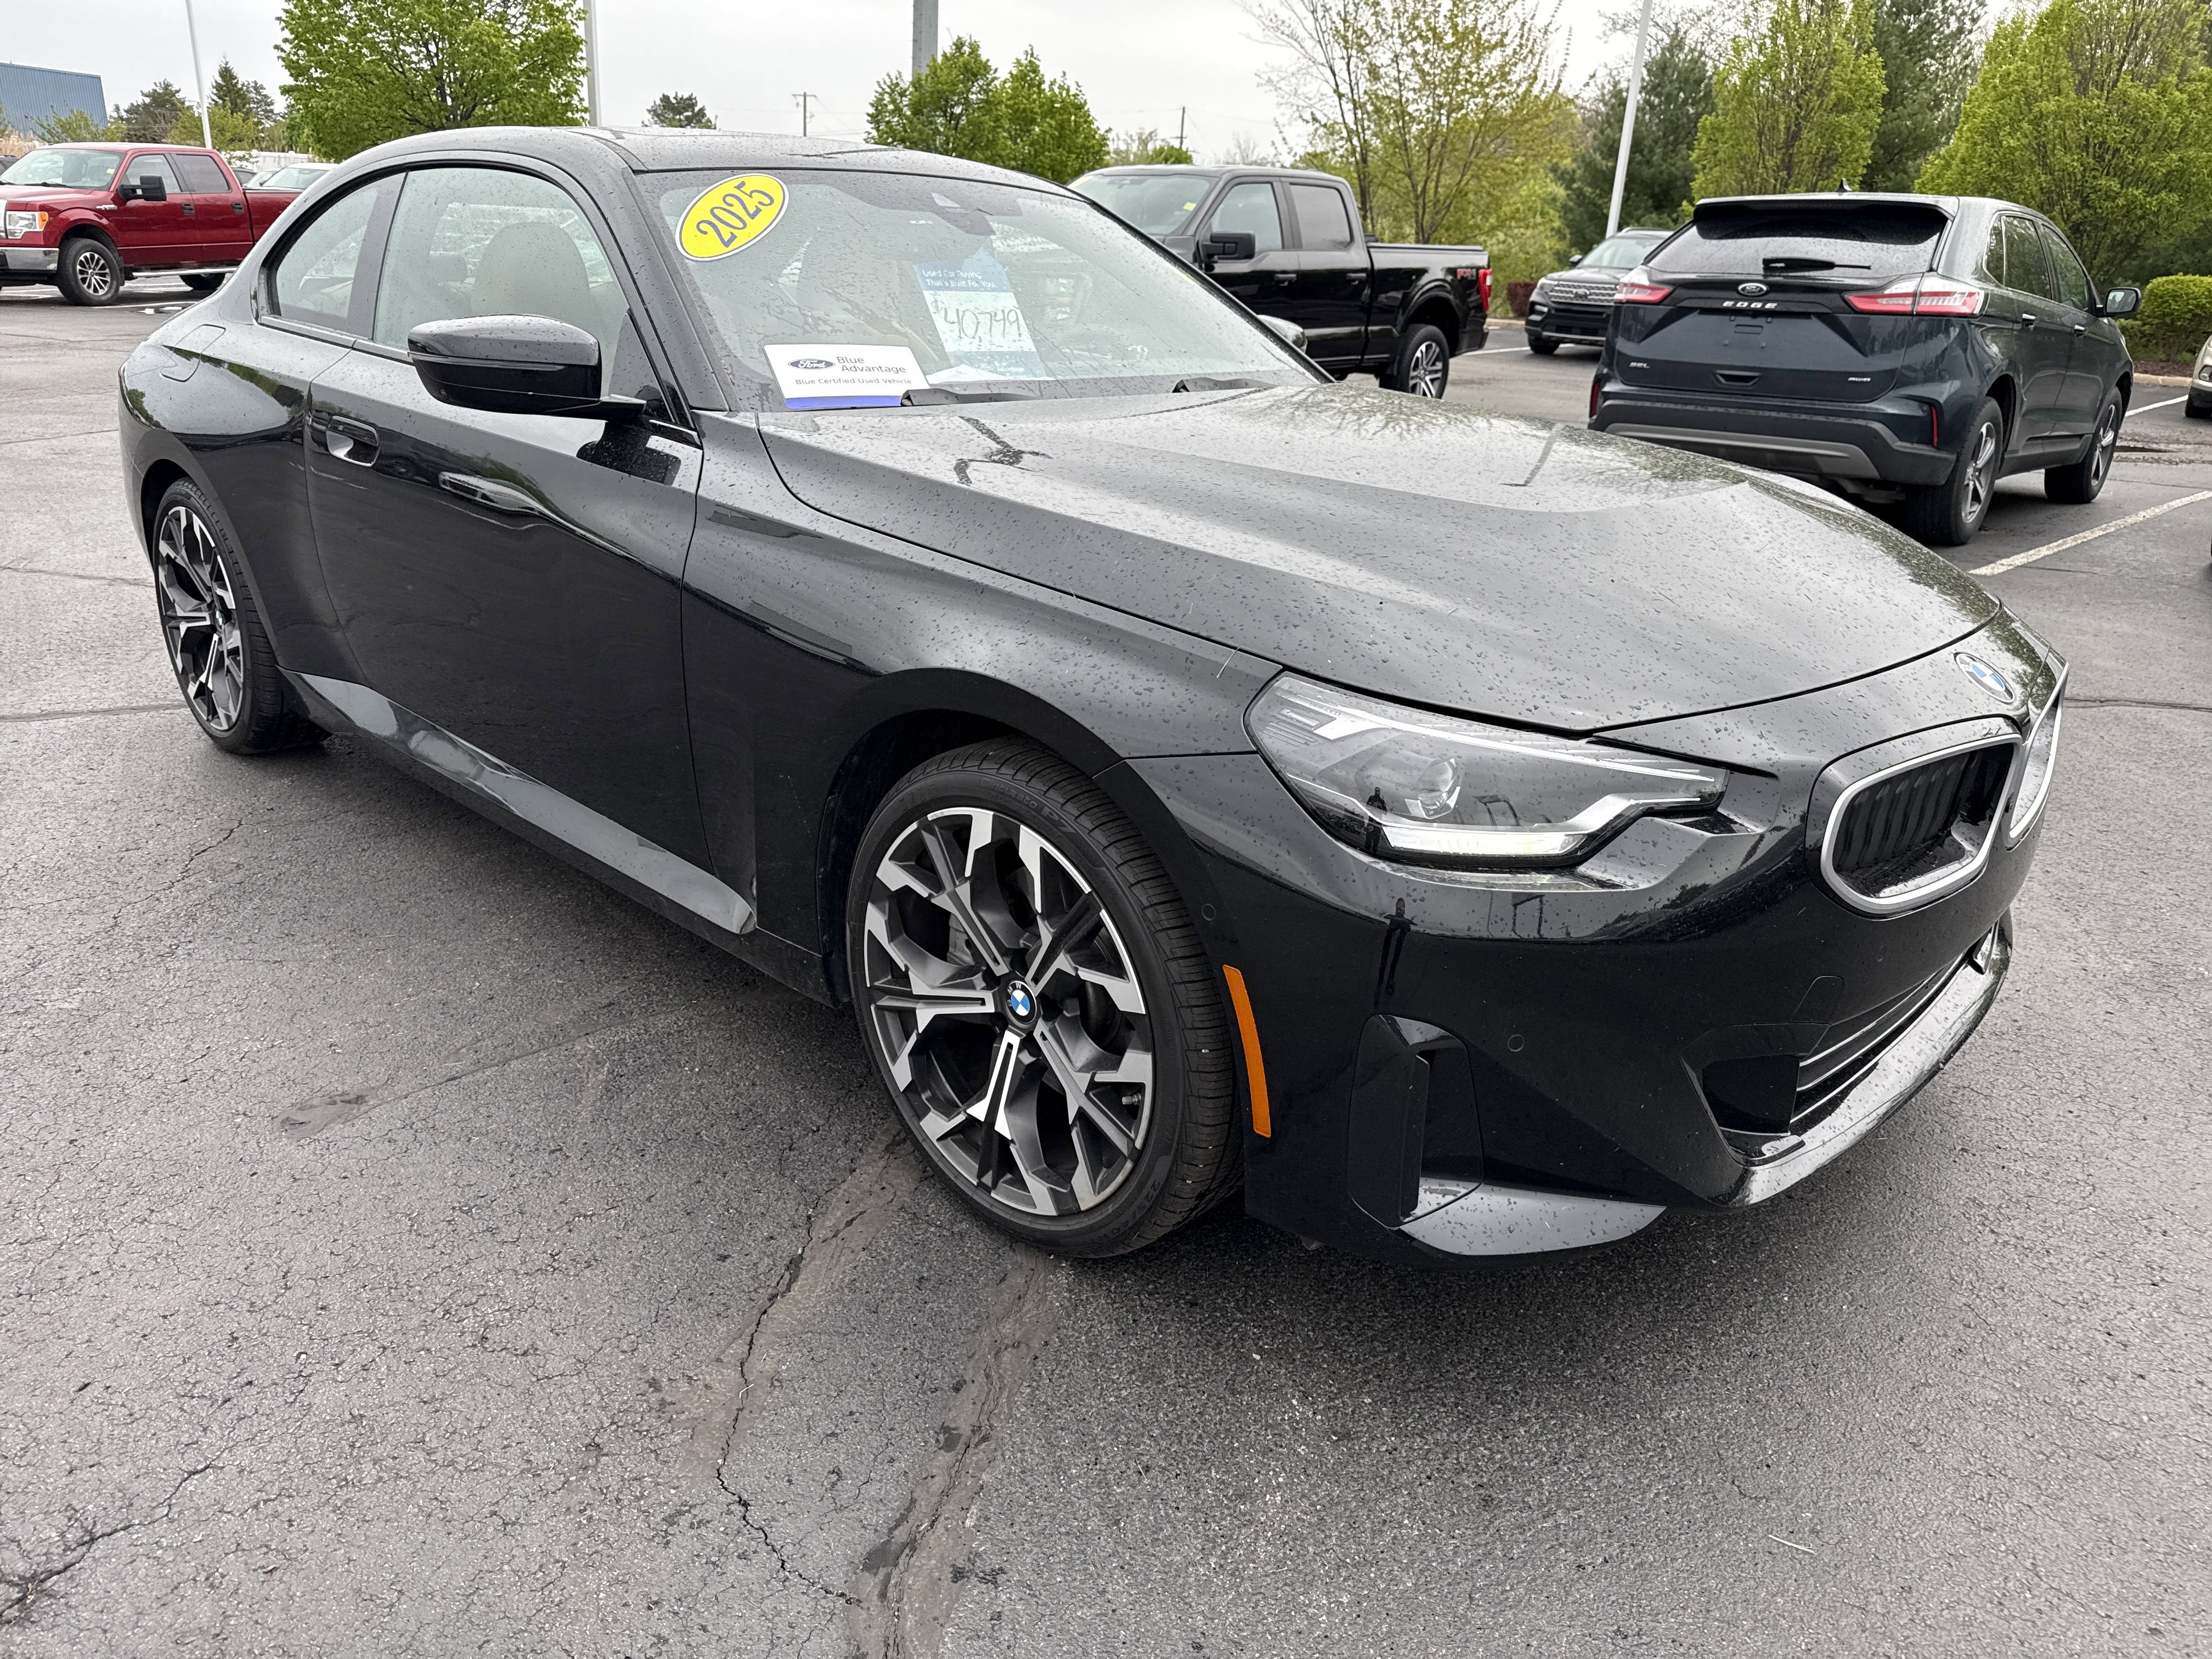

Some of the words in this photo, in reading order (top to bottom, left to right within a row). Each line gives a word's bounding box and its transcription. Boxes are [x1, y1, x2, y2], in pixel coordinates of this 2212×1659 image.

[696, 180, 775, 249] 2025
[797, 359, 827, 369] Ford
[842, 365, 906, 374] Advantage
[980, 777, 1038, 809] Cinturato
[1041, 805, 1077, 834] P7
